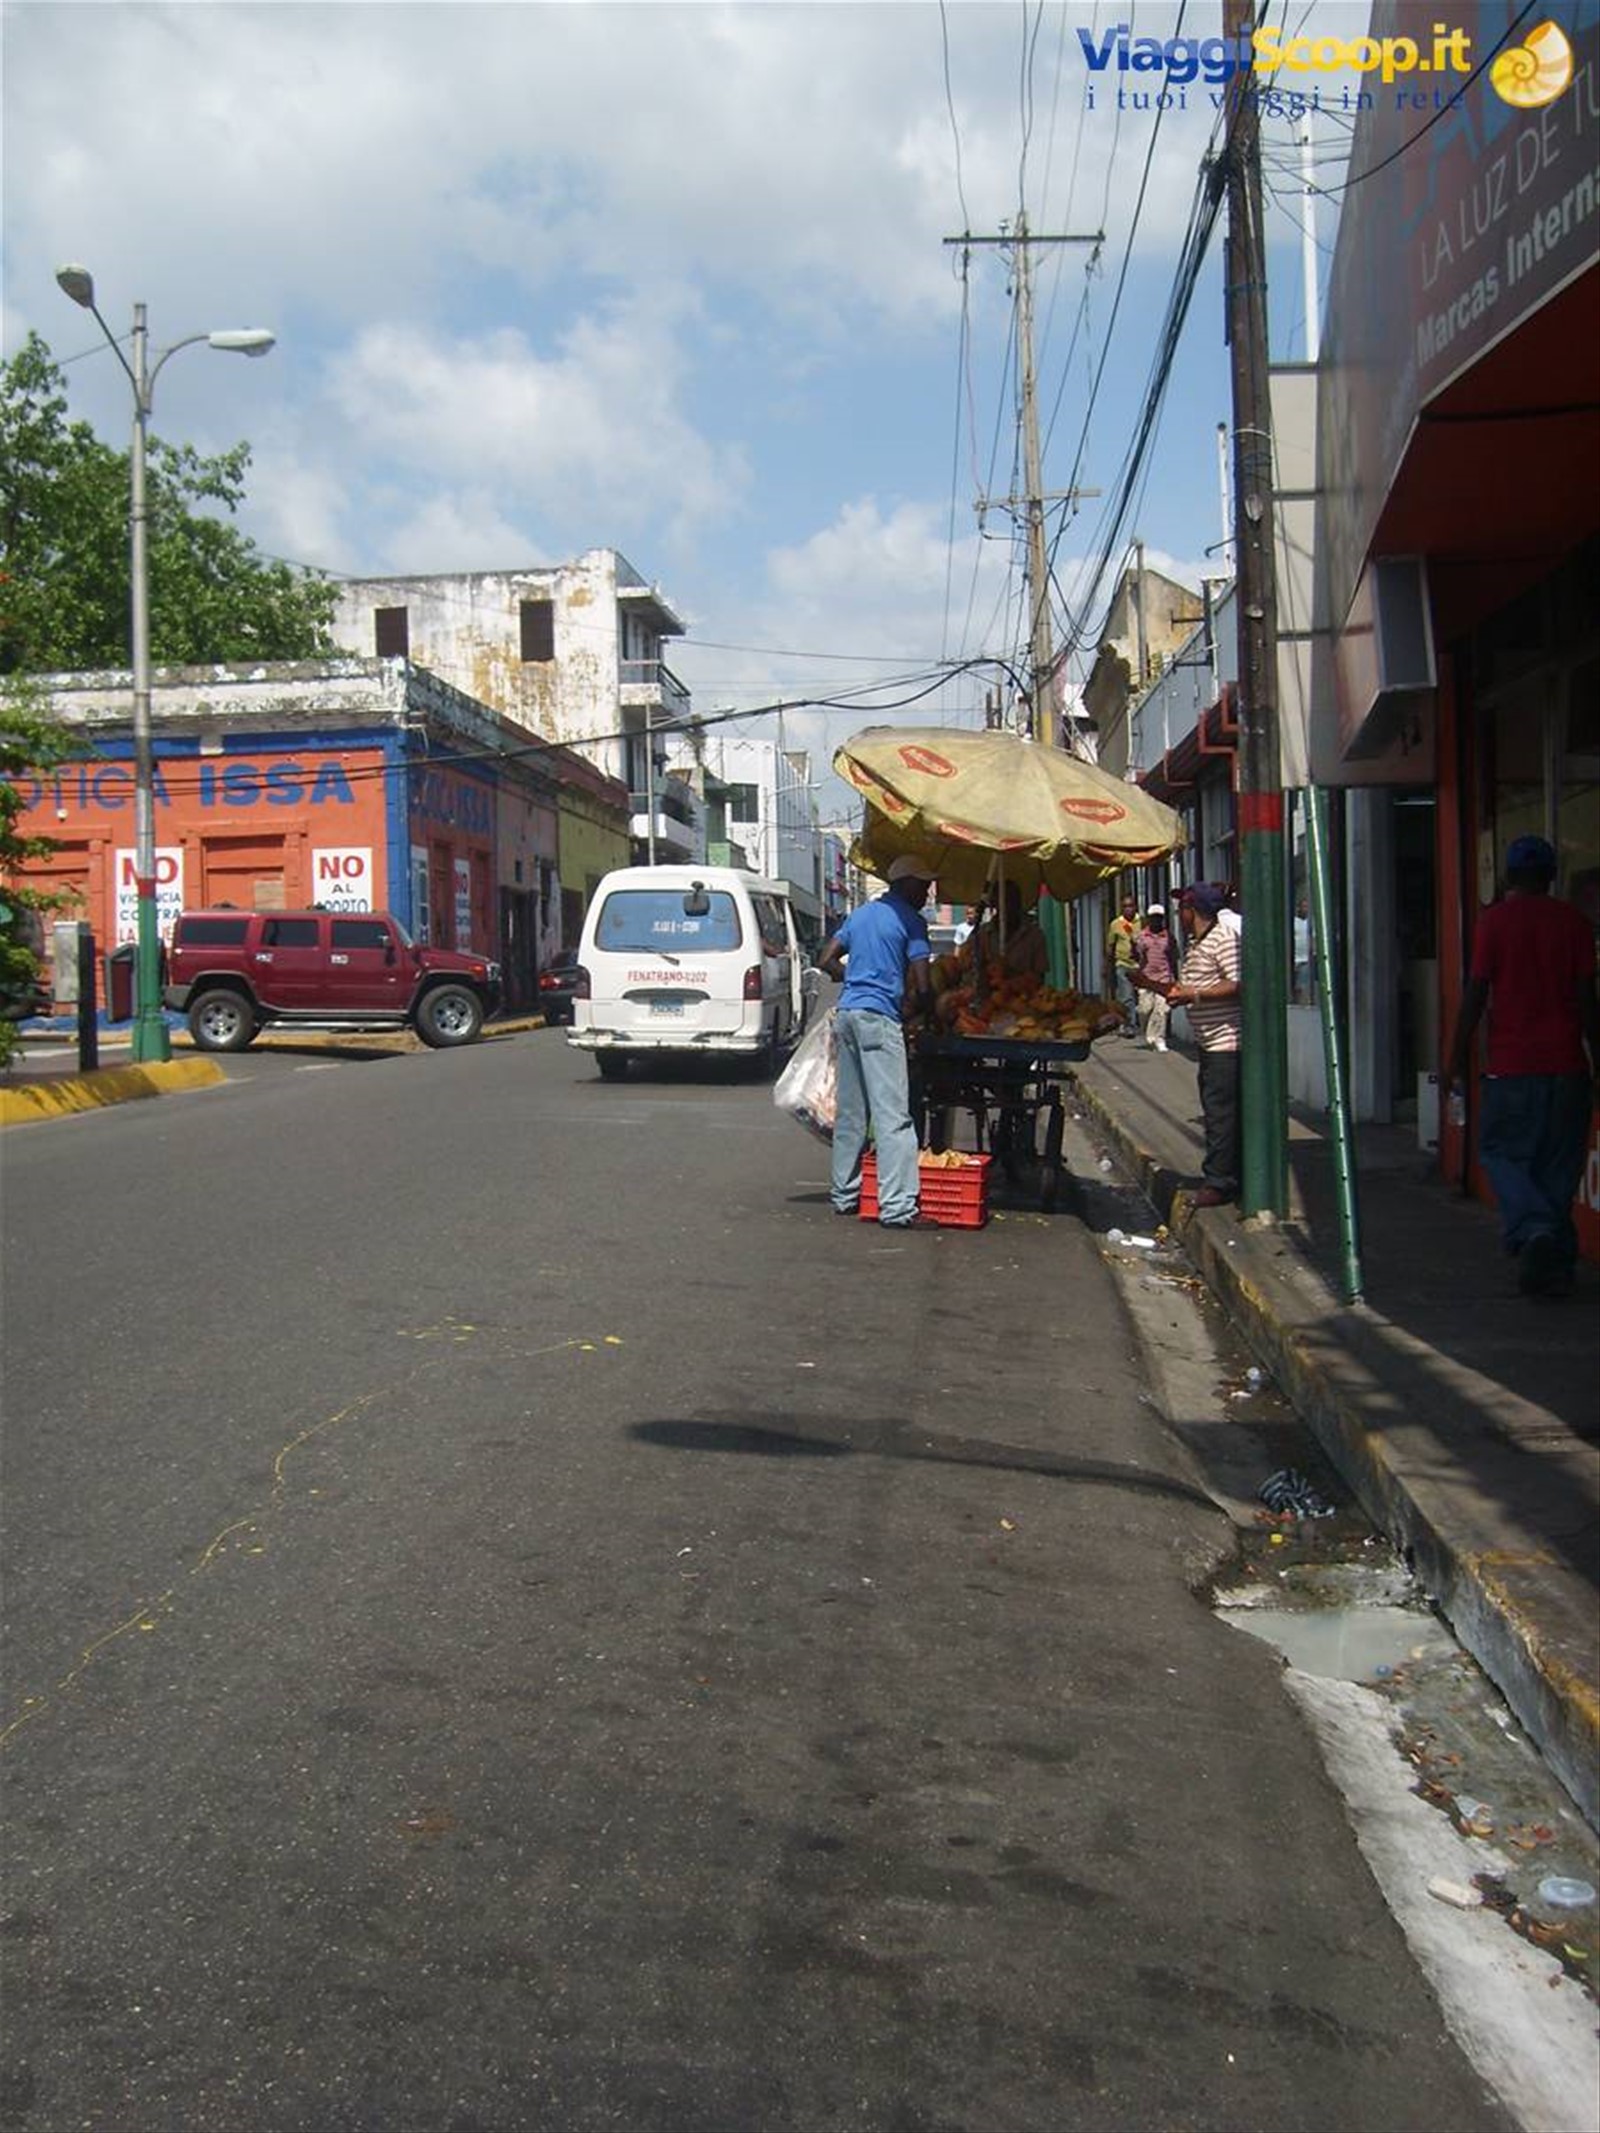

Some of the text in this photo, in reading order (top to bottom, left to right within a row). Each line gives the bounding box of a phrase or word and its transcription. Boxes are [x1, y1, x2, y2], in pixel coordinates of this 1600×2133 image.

[1420, 221, 1454, 291] LA
[1458, 158, 1509, 252] LUZ
[1516, 107, 1560, 194] DE
[1416, 264, 1501, 367] Marcas
[200, 761, 356, 806] ISSA
[319, 855, 365, 879] NO
[331, 883, 354, 894] AL
